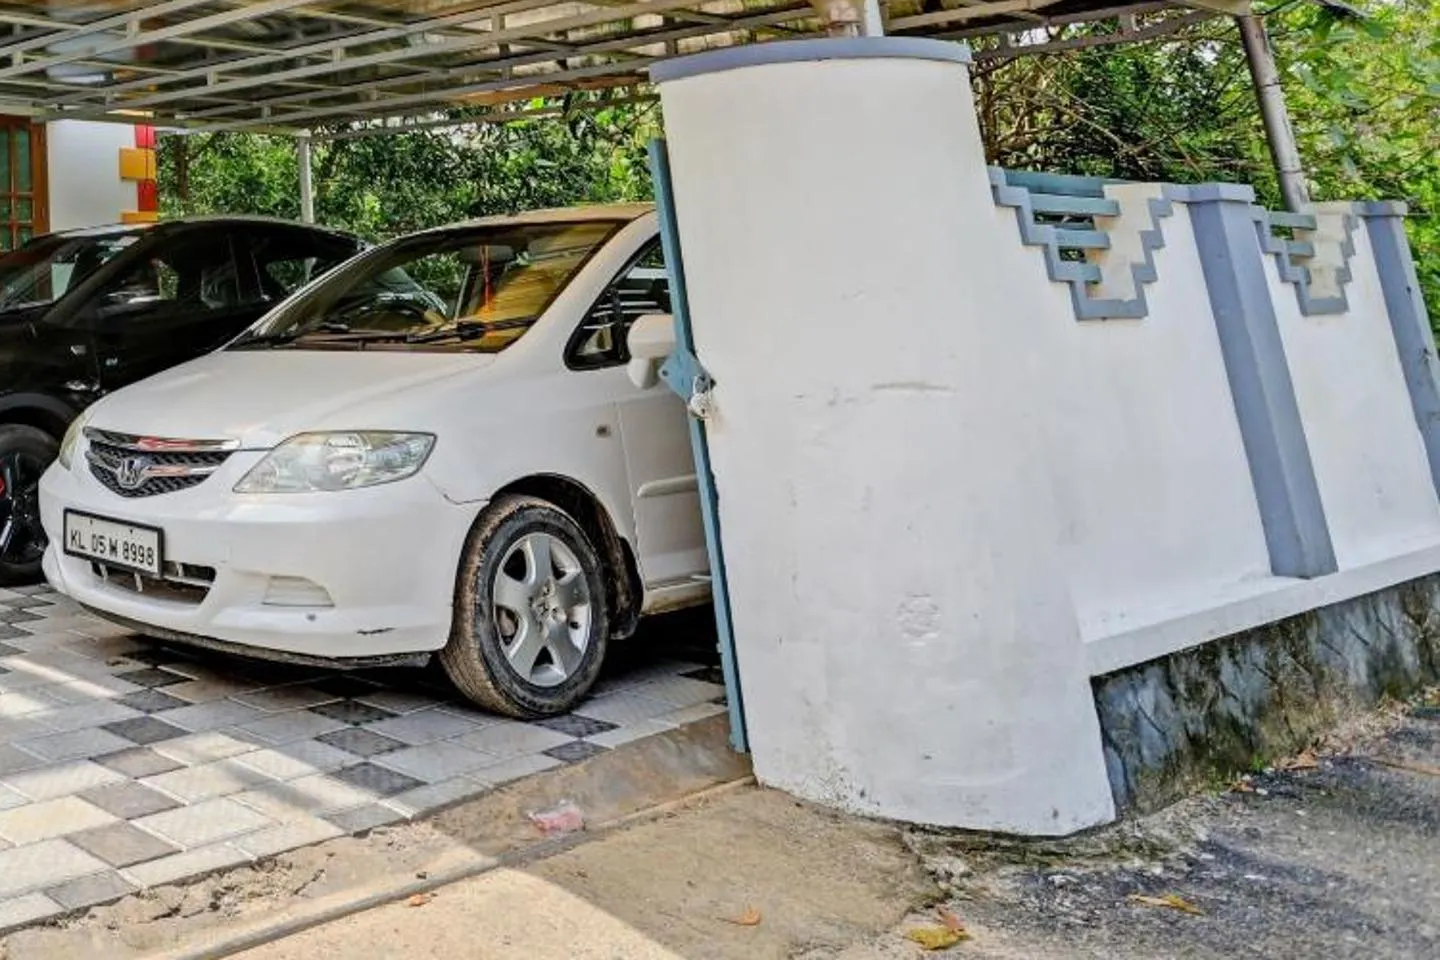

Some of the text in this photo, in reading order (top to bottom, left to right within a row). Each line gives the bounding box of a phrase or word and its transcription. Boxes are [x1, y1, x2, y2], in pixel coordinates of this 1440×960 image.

[70, 529, 85, 550] KL
[91, 534, 106, 554] 05
[122, 540, 154, 566] 8998
